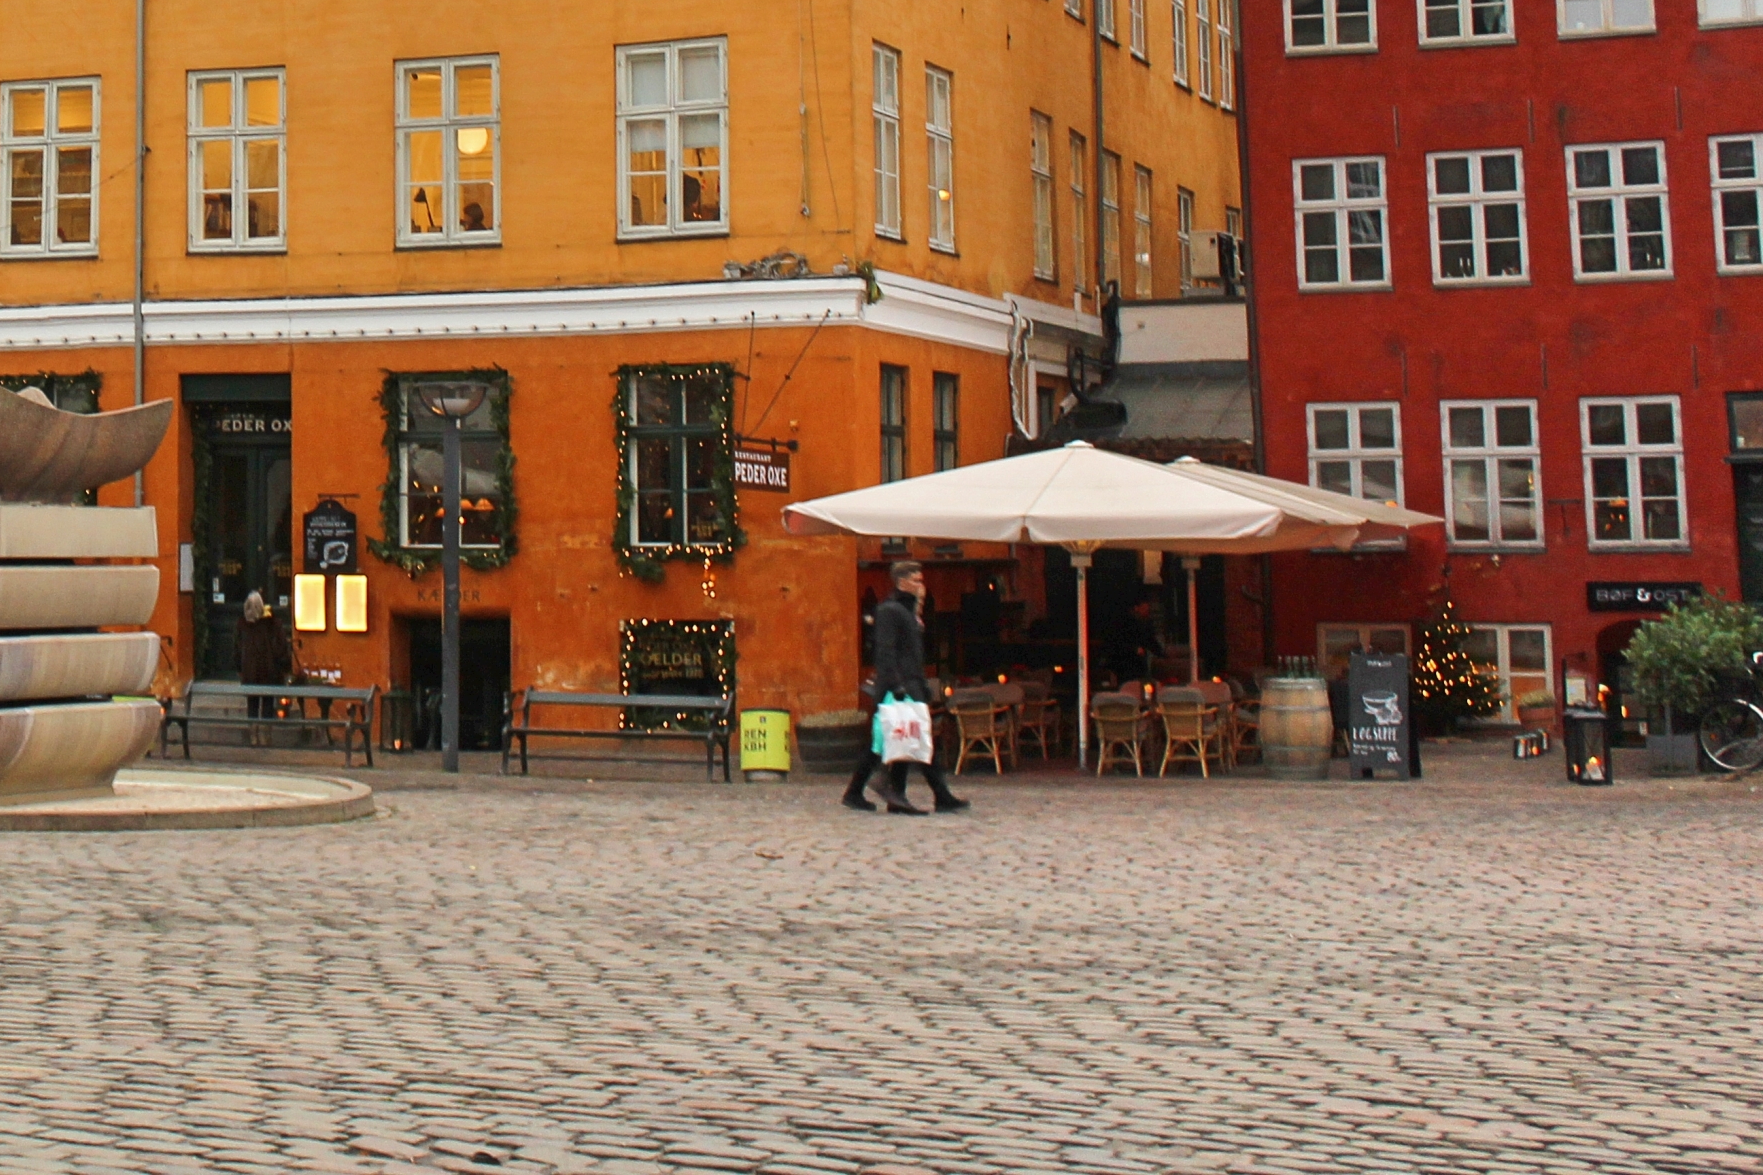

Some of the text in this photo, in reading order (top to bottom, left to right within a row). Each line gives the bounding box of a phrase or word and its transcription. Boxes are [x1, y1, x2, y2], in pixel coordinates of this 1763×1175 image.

[735, 462, 787, 487] PEDER OXE
[1636, 588, 1651, 602] &
